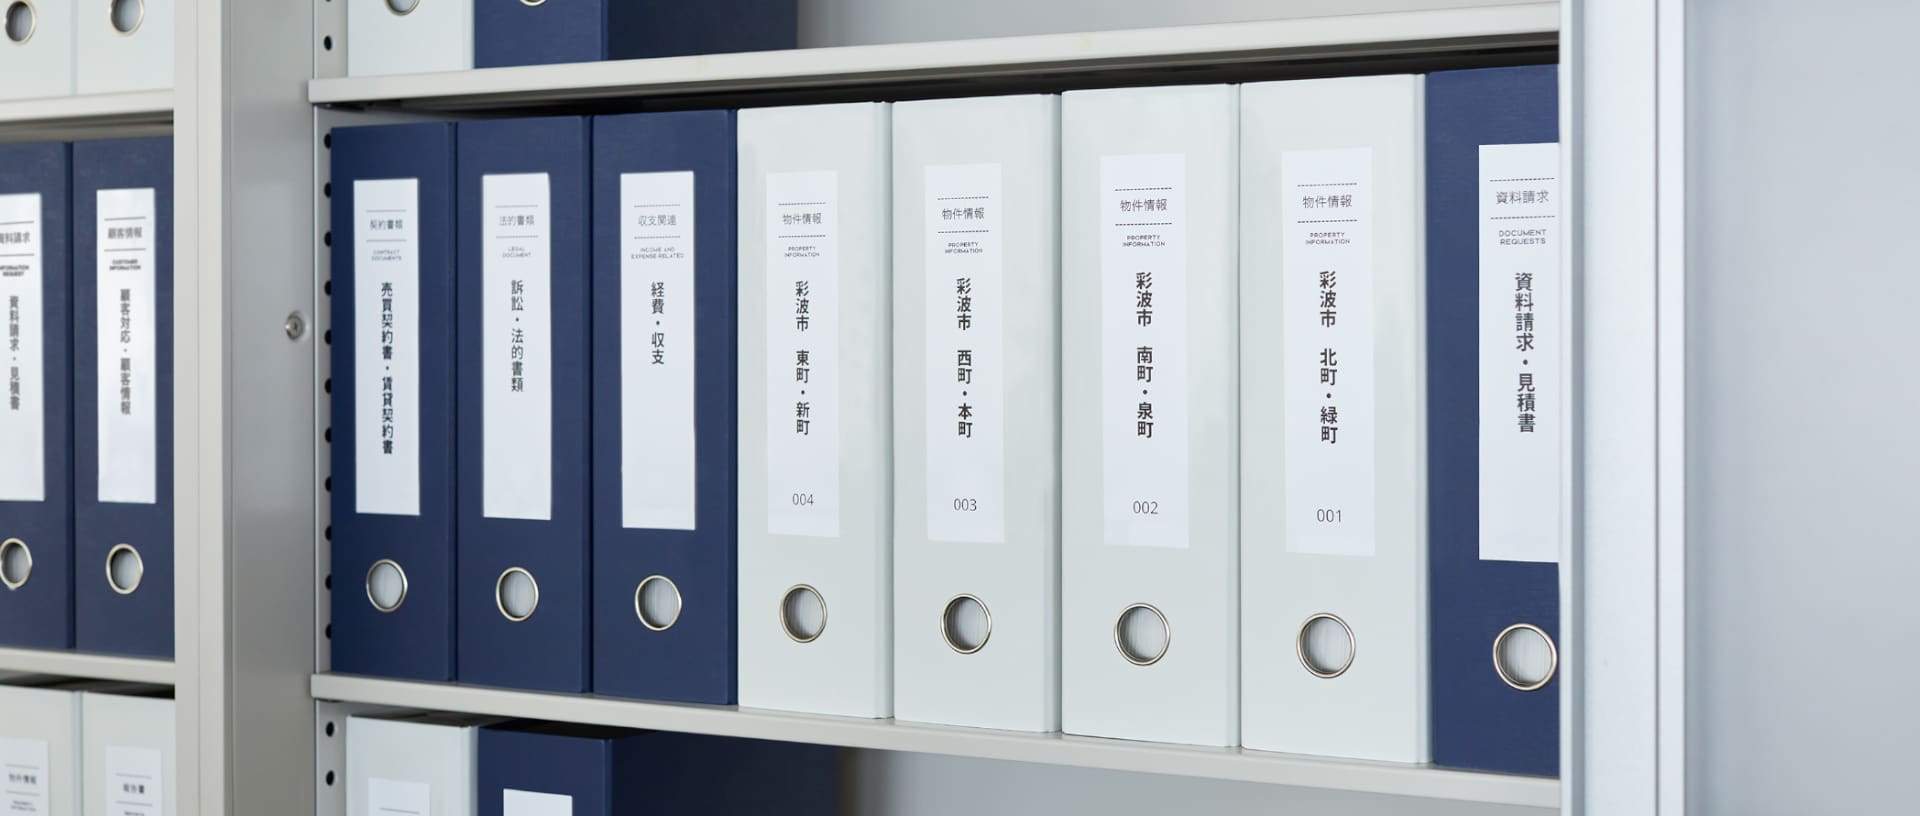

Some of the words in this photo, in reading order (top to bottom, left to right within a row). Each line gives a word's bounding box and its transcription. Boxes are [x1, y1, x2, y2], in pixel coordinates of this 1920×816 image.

[1303, 195, 1352, 208] 物件情報
[1496, 190, 1549, 204] 資料請求
[1120, 199, 1167, 211] 物件情報
[500, 215, 534, 226] 法的書類
[638, 214, 676, 226] 収支関連
[783, 213, 821, 224] 物件情報
[942, 208, 984, 220] 物件情報
[369, 219, 403, 230] 契約書類
[108, 227, 142, 239] 顧客情報
[1499, 229, 1546, 237] DOCUMENT
[957, 278, 971, 330] 彩波市
[1136, 272, 1152, 327] 彩波市
[1320, 271, 1336, 327] 彩波市
[796, 281, 809, 332] 彩波市
[651, 282, 664, 364] 経費・収支
[512, 280, 523, 392] 訴訟・法的書類
[1515, 273, 1535, 432] 資料請求・見積書
[382, 282, 393, 454] 売買契約書・賃貸契約書
[796, 350, 810, 435] 東町・新町
[957, 350, 972, 438] 西町・本町
[1137, 346, 1154, 438] 南町・泉町
[1320, 348, 1338, 444] 北町・緑町
[792, 493, 814, 506] 004
[954, 498, 976, 511] 003
[1133, 501, 1158, 514] 002
[1317, 509, 1341, 522] 001
